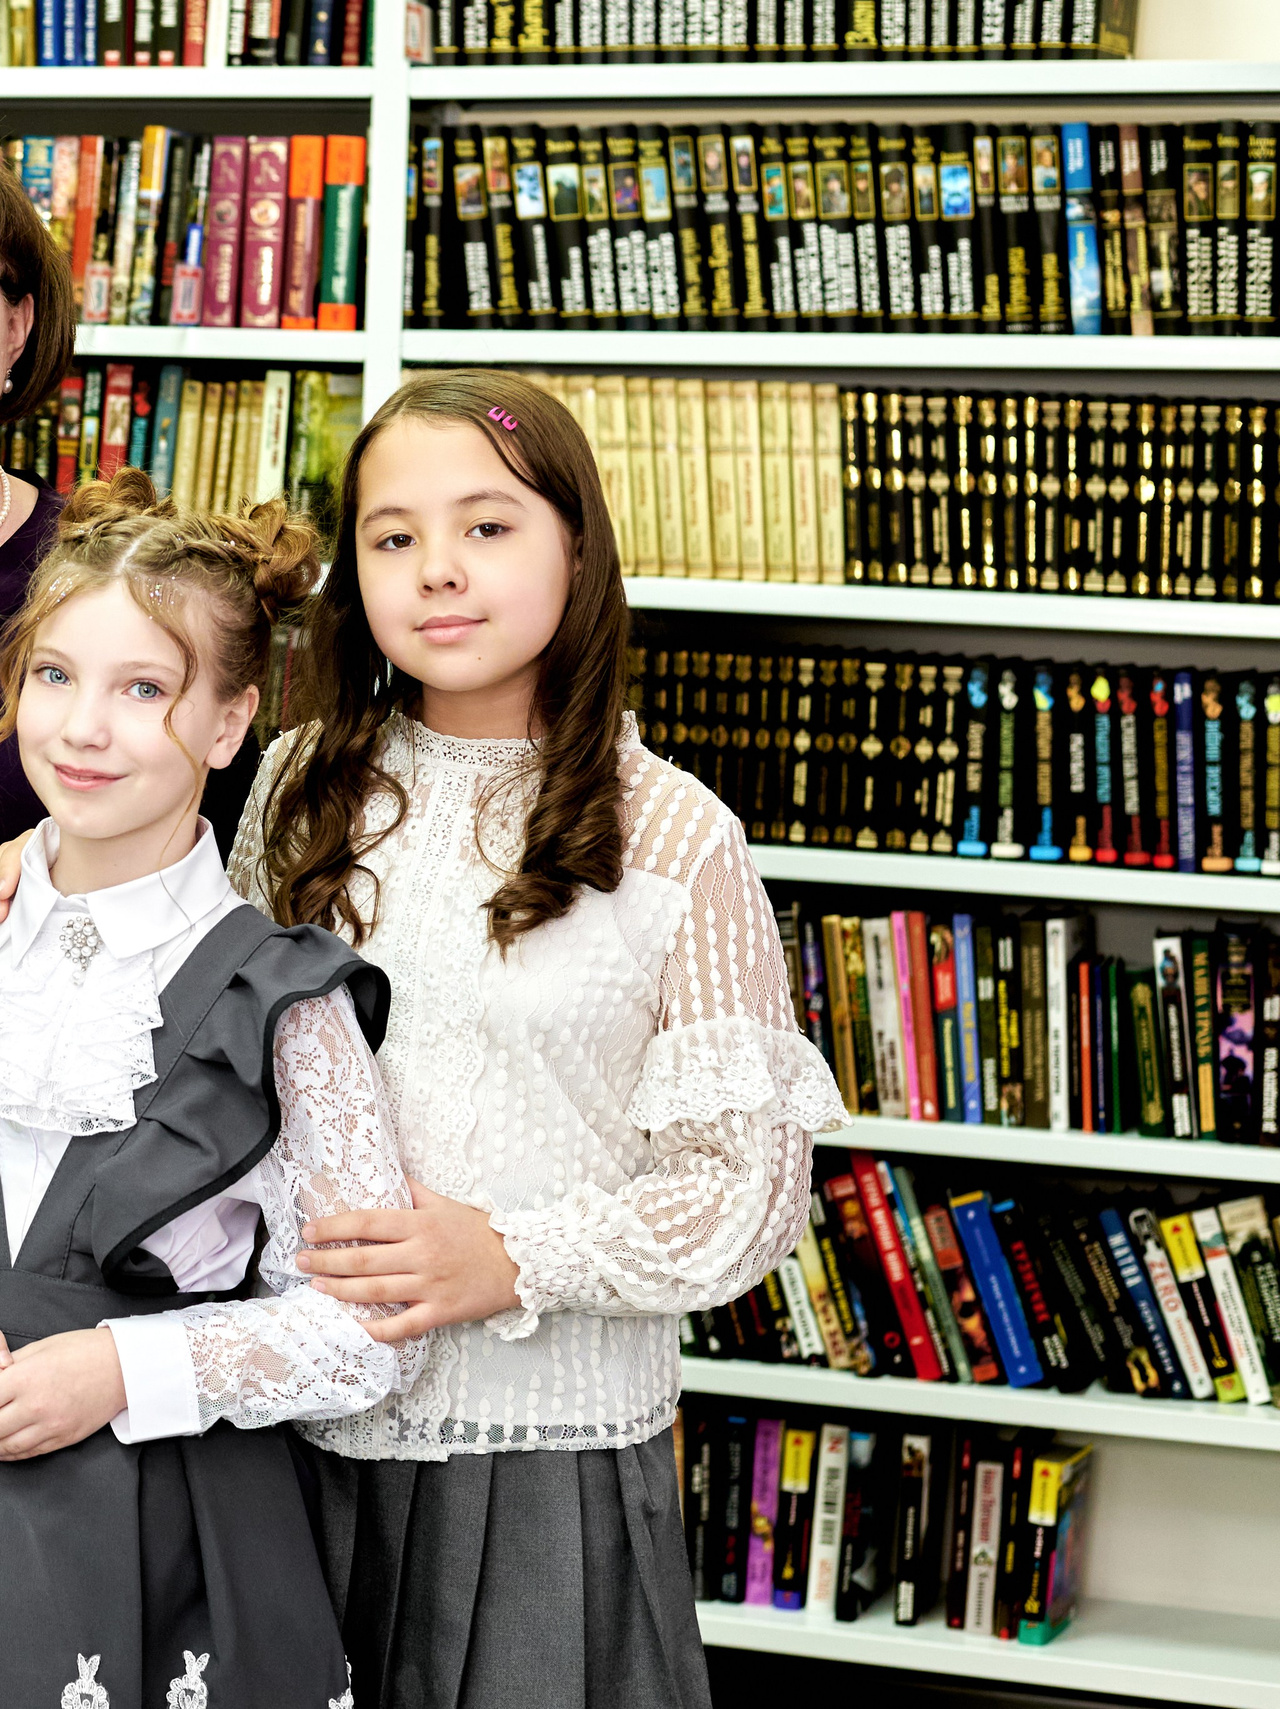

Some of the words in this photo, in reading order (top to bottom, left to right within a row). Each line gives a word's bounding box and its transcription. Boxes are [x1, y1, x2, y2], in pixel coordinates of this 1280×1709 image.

[1187, 228, 1201, 315] МИХАИЛ
[1217, 226, 1230, 313] МИХАИЛ
[1246, 228, 1261, 315] МИХАИЛ
[1145, 1255, 1185, 1315] ZERO
